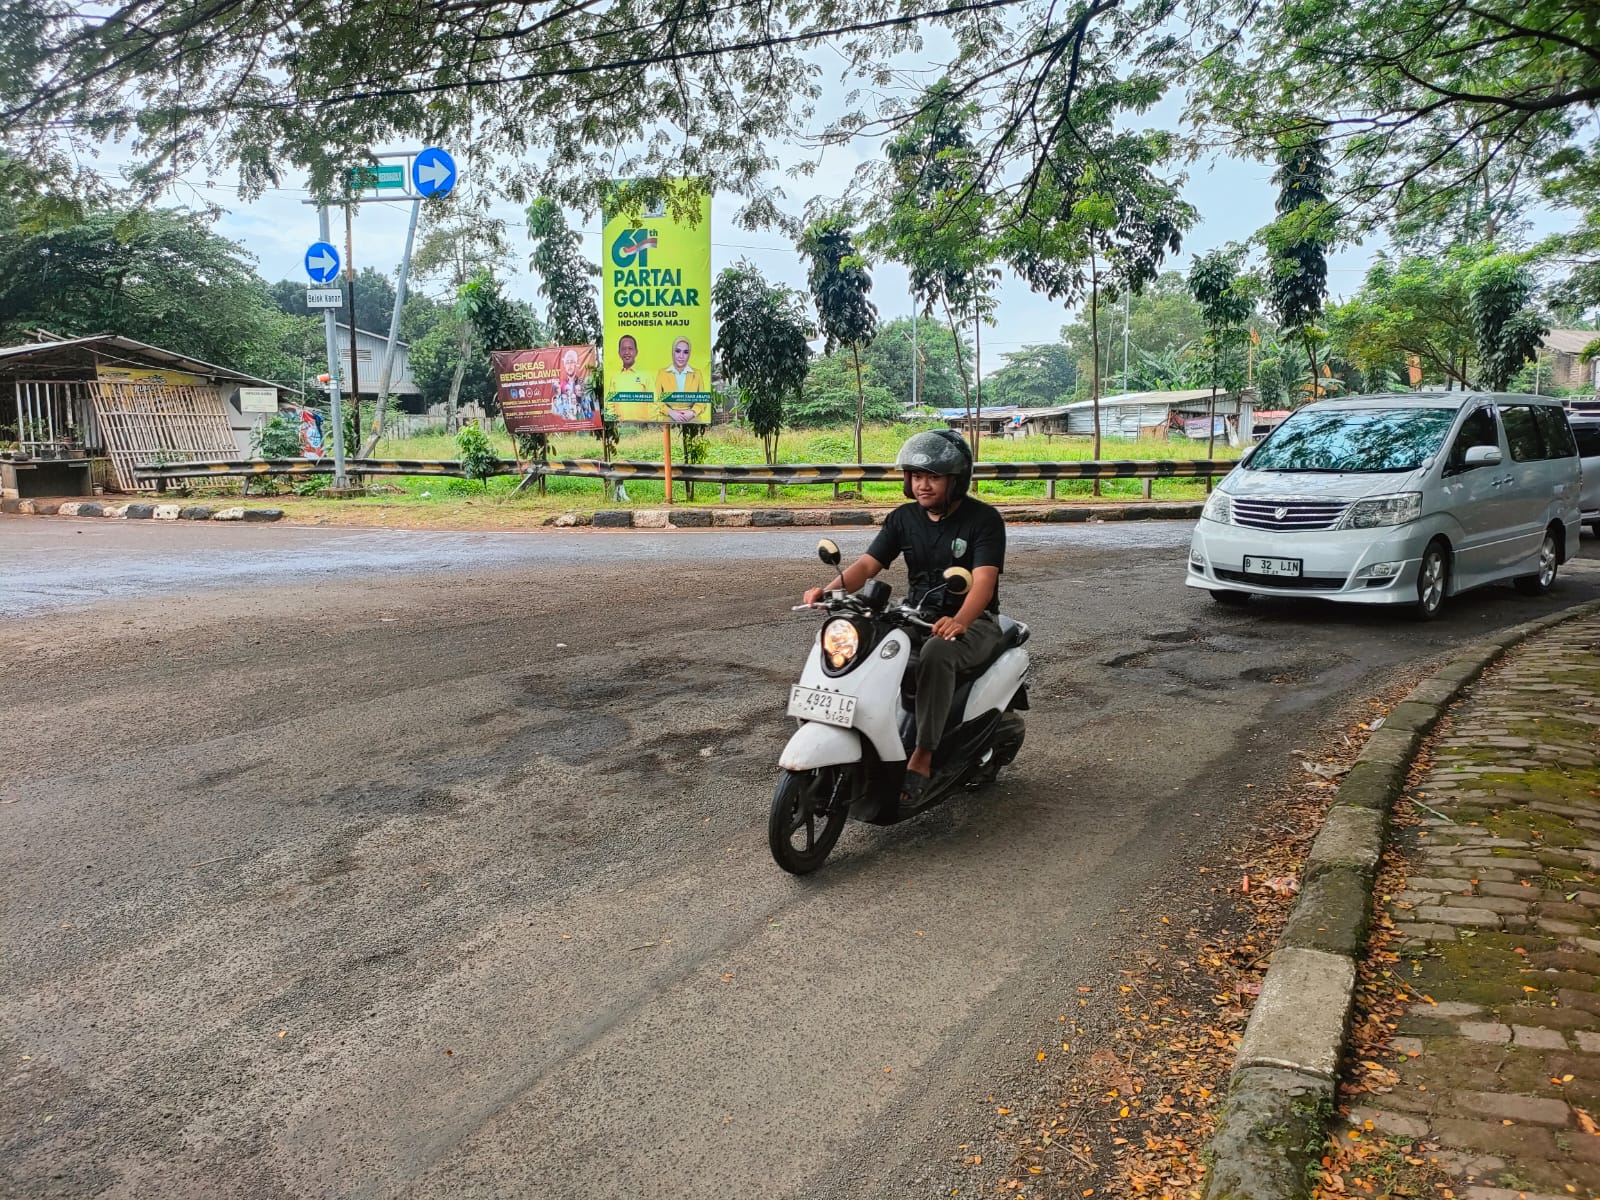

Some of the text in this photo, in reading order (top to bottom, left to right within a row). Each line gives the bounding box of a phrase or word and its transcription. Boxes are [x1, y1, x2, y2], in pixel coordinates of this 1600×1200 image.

[614, 268, 682, 288] PARTAI
[613, 288, 700, 308] GOLKAR
[617, 311, 650, 319] GOLKAR
[618, 319, 663, 327] INDONESIA
[513, 361, 545, 372] CIKEAS
[500, 368, 561, 382] BERSHOLAWAT
[1245, 558, 1251, 568] B
[1260, 559, 1272, 569] 32
[1280, 561, 1299, 572] LIN
[793, 689, 853, 712] F 4923 LC
